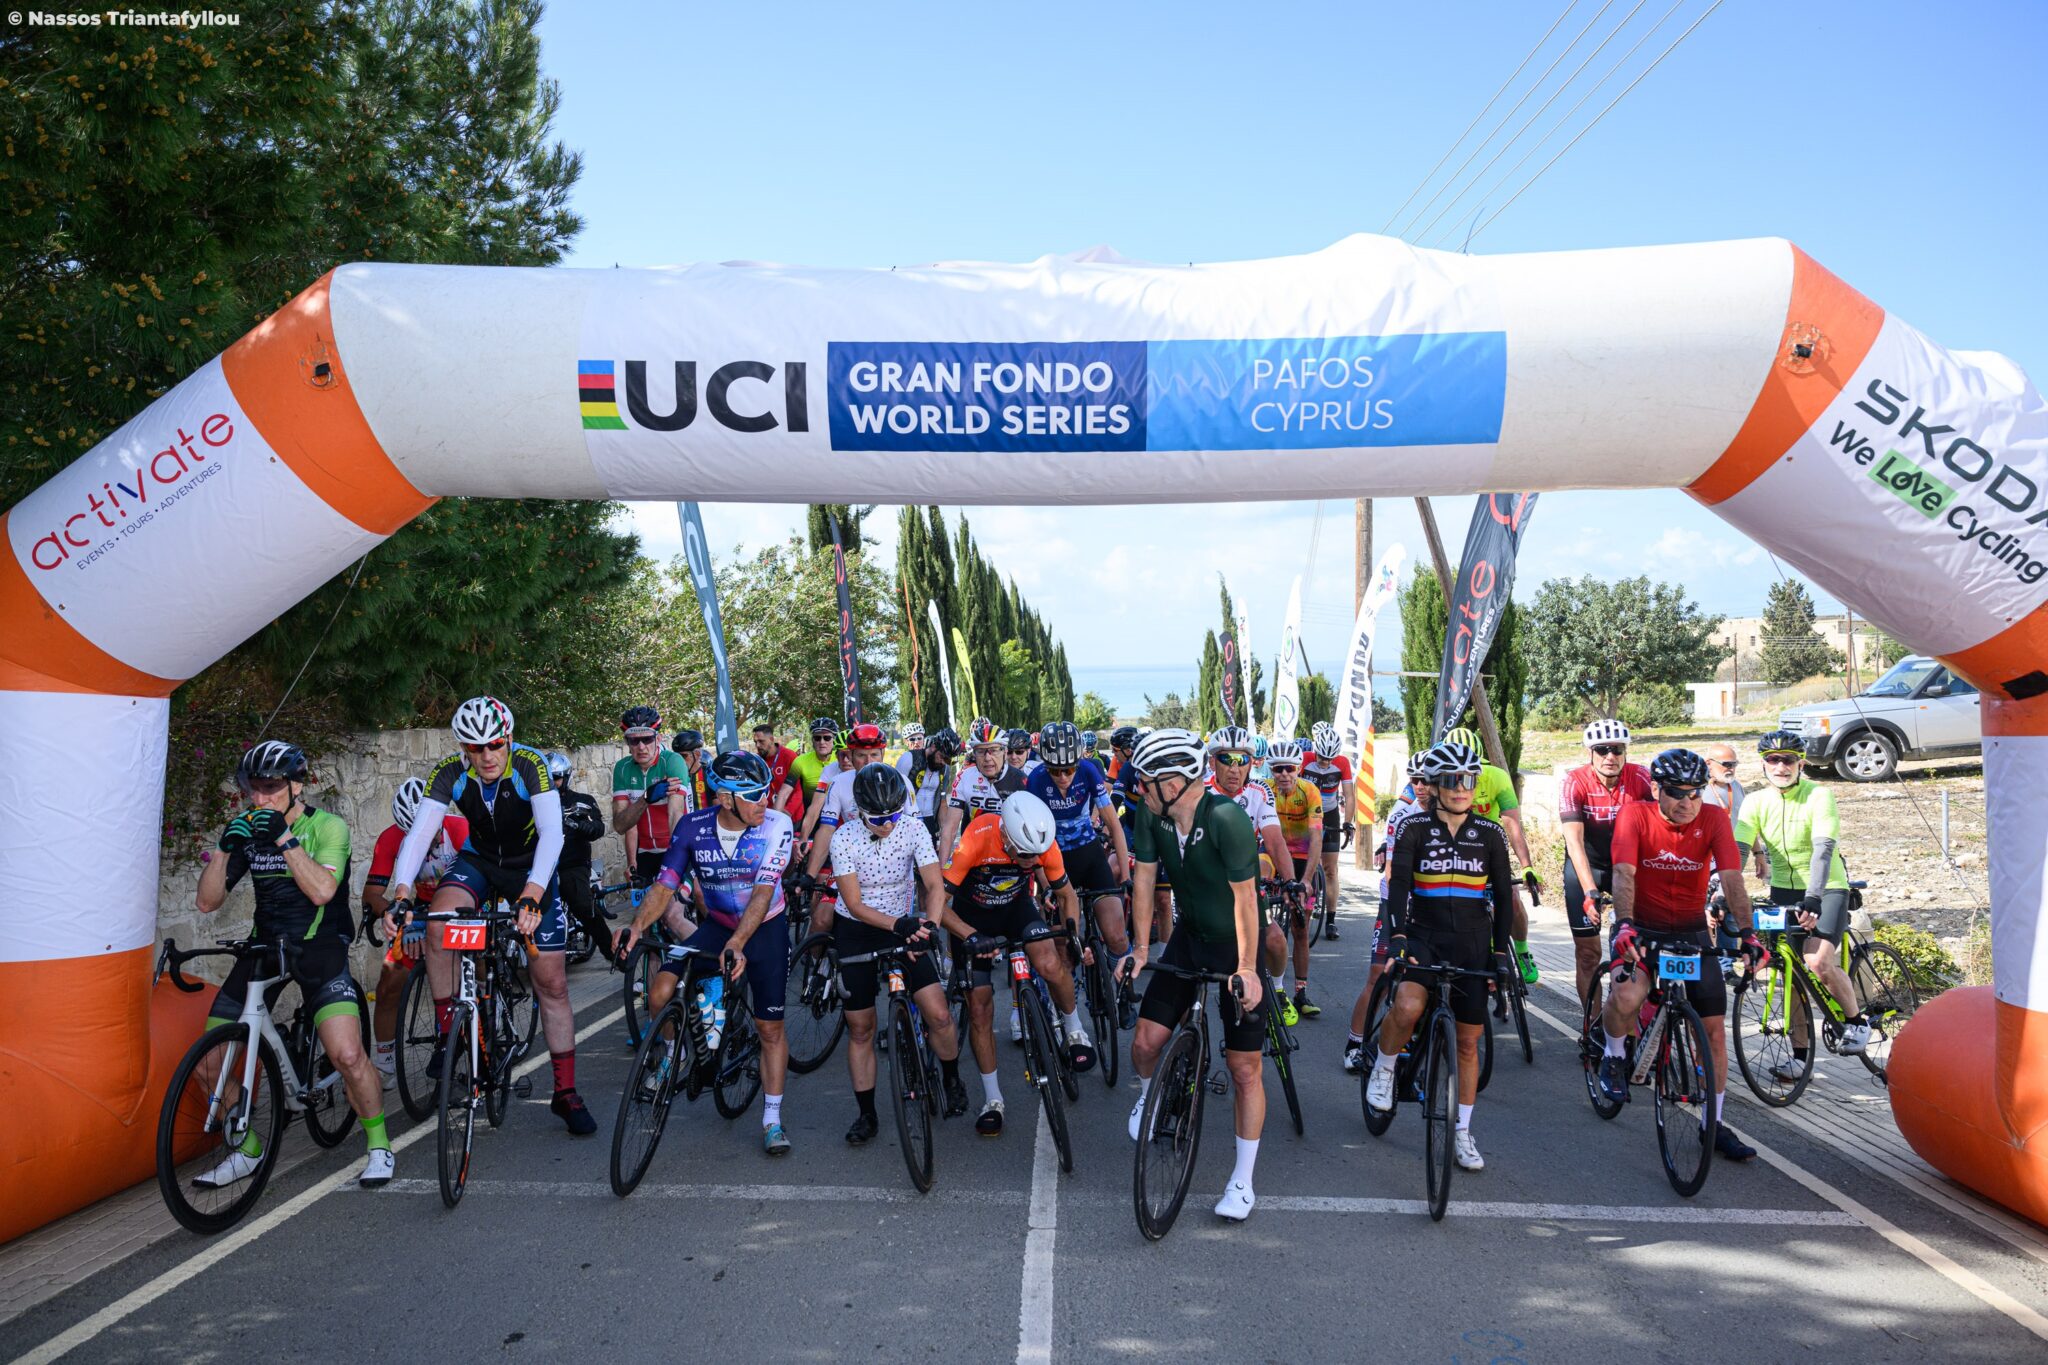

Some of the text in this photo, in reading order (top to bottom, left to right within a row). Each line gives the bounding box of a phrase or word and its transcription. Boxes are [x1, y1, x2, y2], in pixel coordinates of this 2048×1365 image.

[849, 361, 1114, 394] GRAN FONDO
[1253, 356, 1374, 390] PAFOS
[625, 360, 809, 432] UCI
[849, 404, 1130, 435] WORLD SERIES
[1251, 399, 1393, 432] CYPRUS
[31, 413, 234, 570] activate
[1830, 420, 1876, 466] We
[1947, 505, 2048, 584] Cycling
[77, 461, 222, 571] EVENTS TOURS ADVENTURES
[1442, 696, 1466, 735] TOURS
[1396, 816, 1432, 840] NORTHCOM
[1420, 853, 1484, 873] peplink
[450, 929, 480, 944] 717
[1665, 959, 1695, 975] 603
